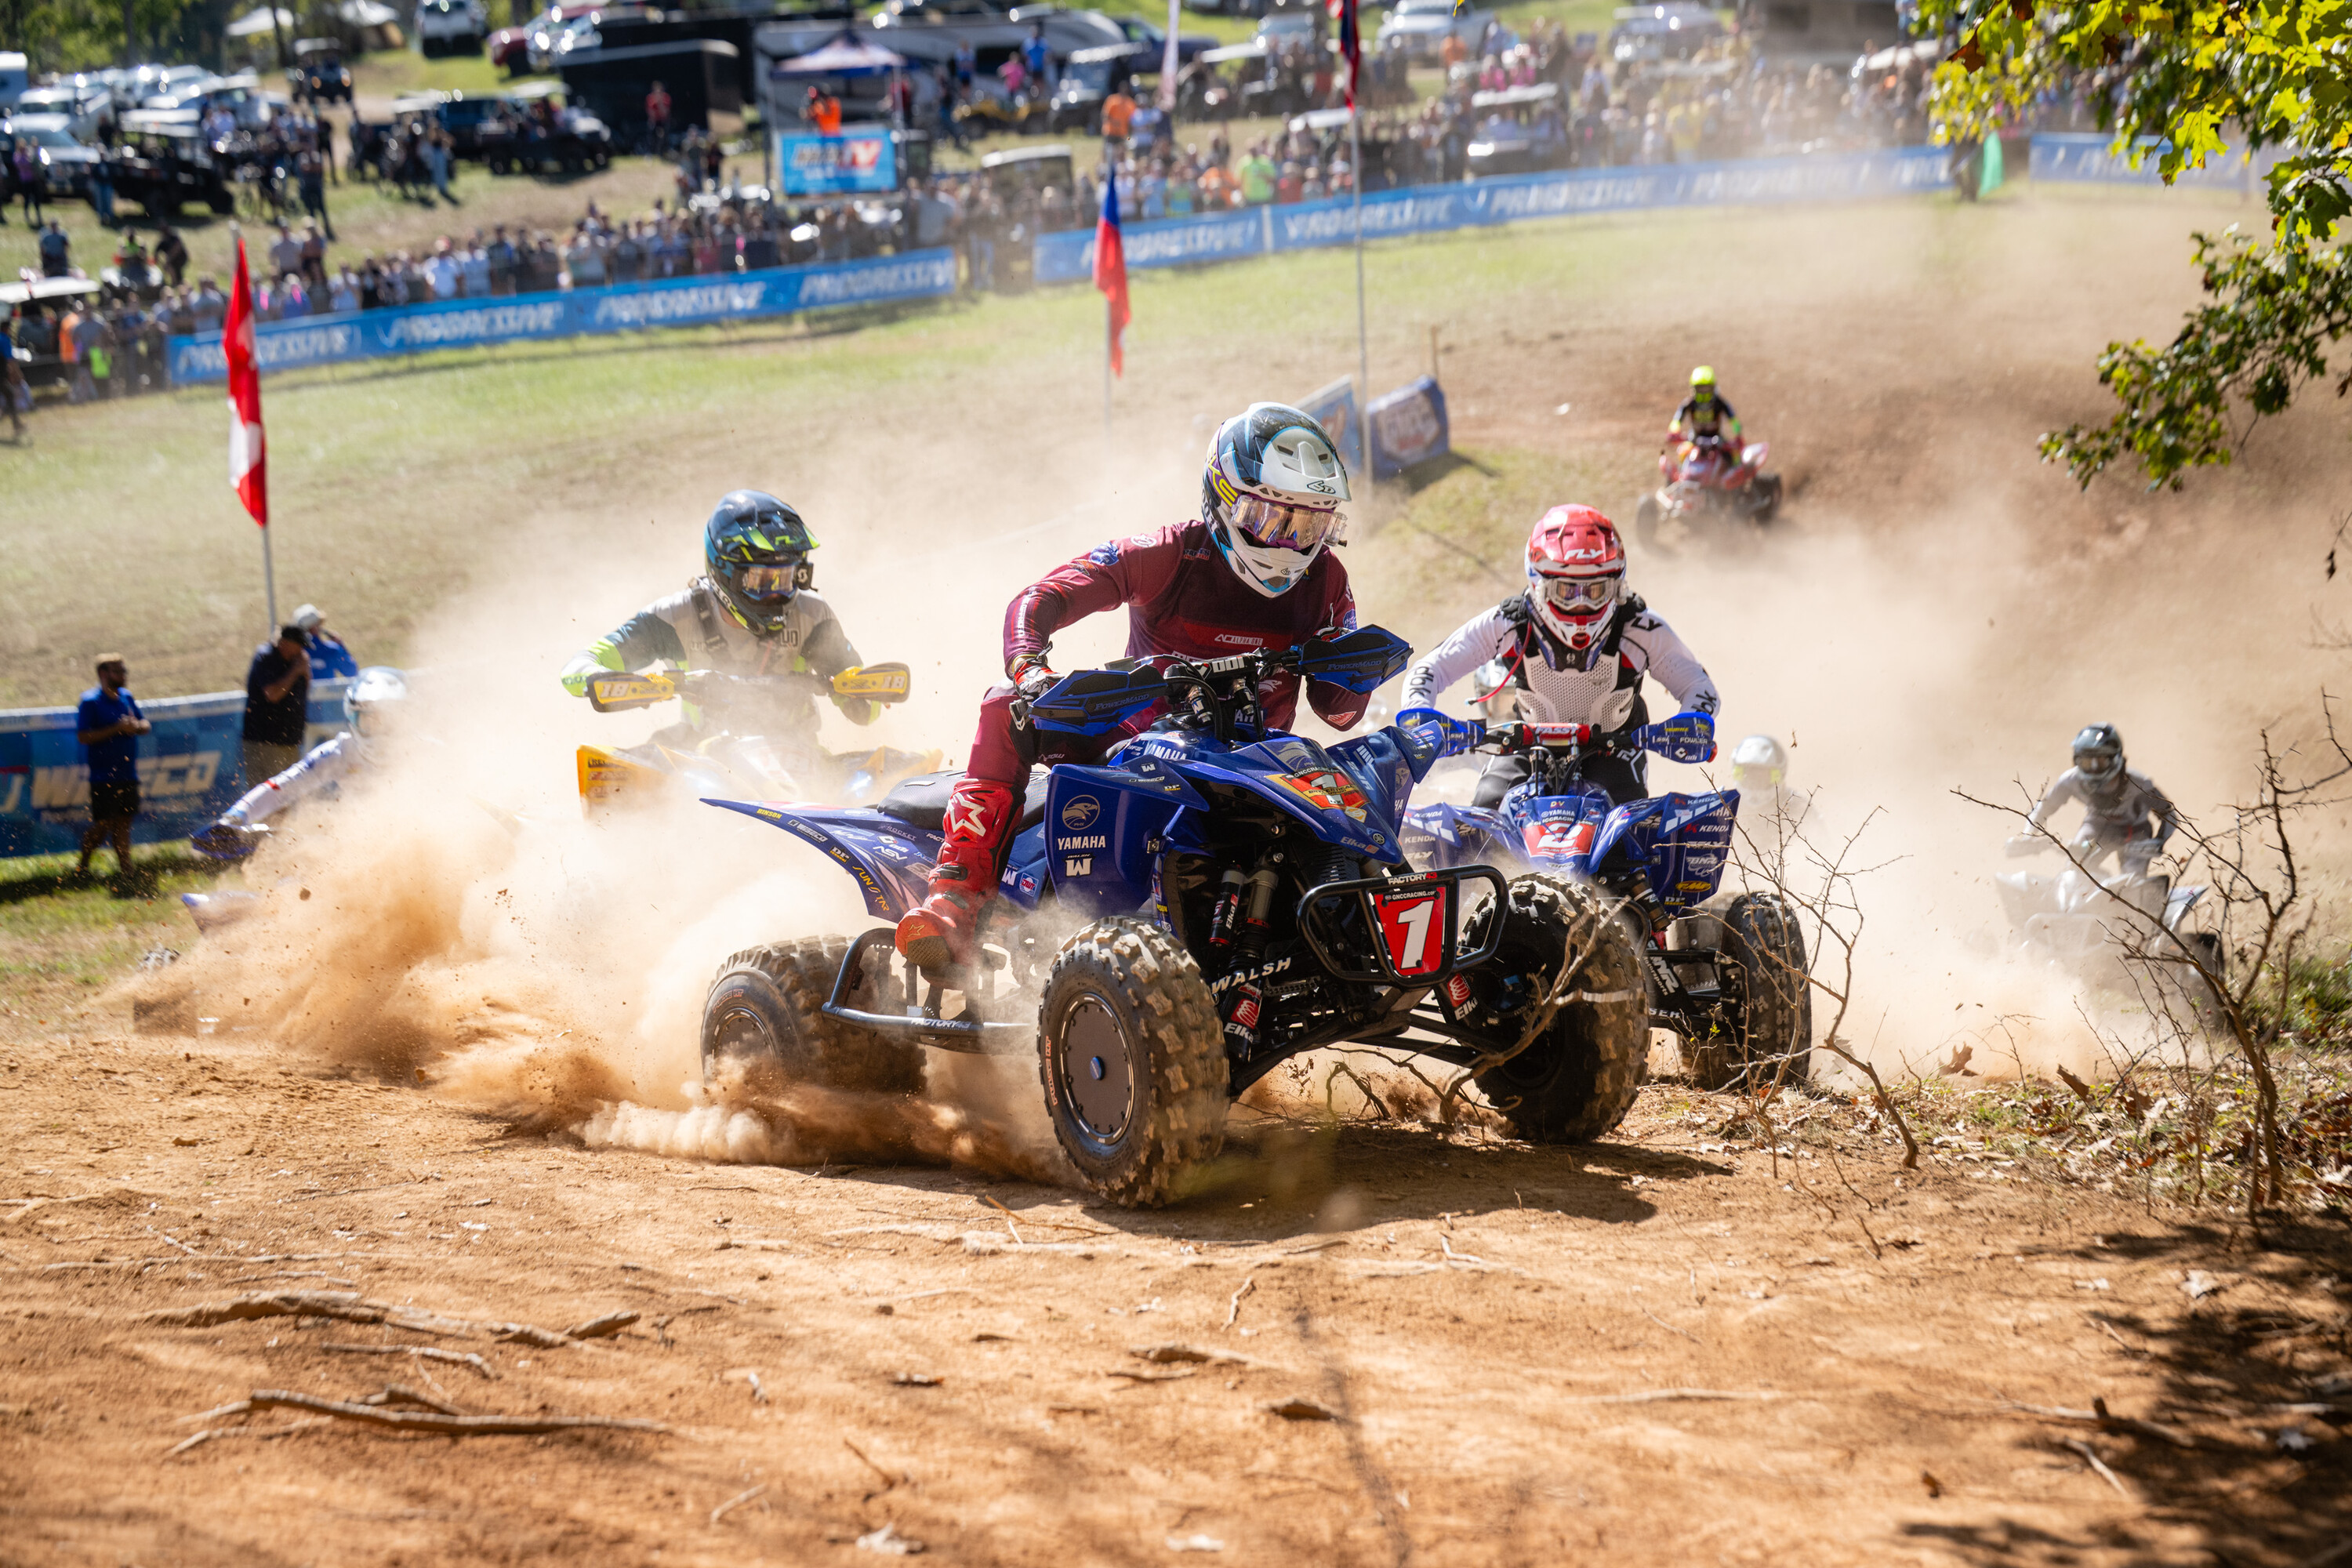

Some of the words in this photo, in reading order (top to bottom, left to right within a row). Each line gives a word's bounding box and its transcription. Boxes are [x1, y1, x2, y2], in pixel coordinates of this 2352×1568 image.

[1563, 548, 1604, 561] FLY
[1631, 615, 1664, 632] LY
[881, 676, 906, 689] 18
[1409, 666, 1434, 699] dbk
[600, 683, 630, 698] 18
[1688, 797, 1716, 805] KENDA
[1414, 810, 1443, 818] KENDA
[926, 833, 946, 844] FACT
[1340, 836, 1367, 849] Elka
[1405, 835, 1436, 844] KENDA
[1537, 822, 1584, 848] 2
[1057, 835, 1106, 851] YAMAHA
[831, 846, 851, 860] DP
[873, 845, 908, 862] ASV
[1225, 905, 1236, 930] Elka
[1397, 900, 1435, 970] 1
[1211, 956, 1291, 995] WALSH
[1223, 1022, 1254, 1044] Elka
